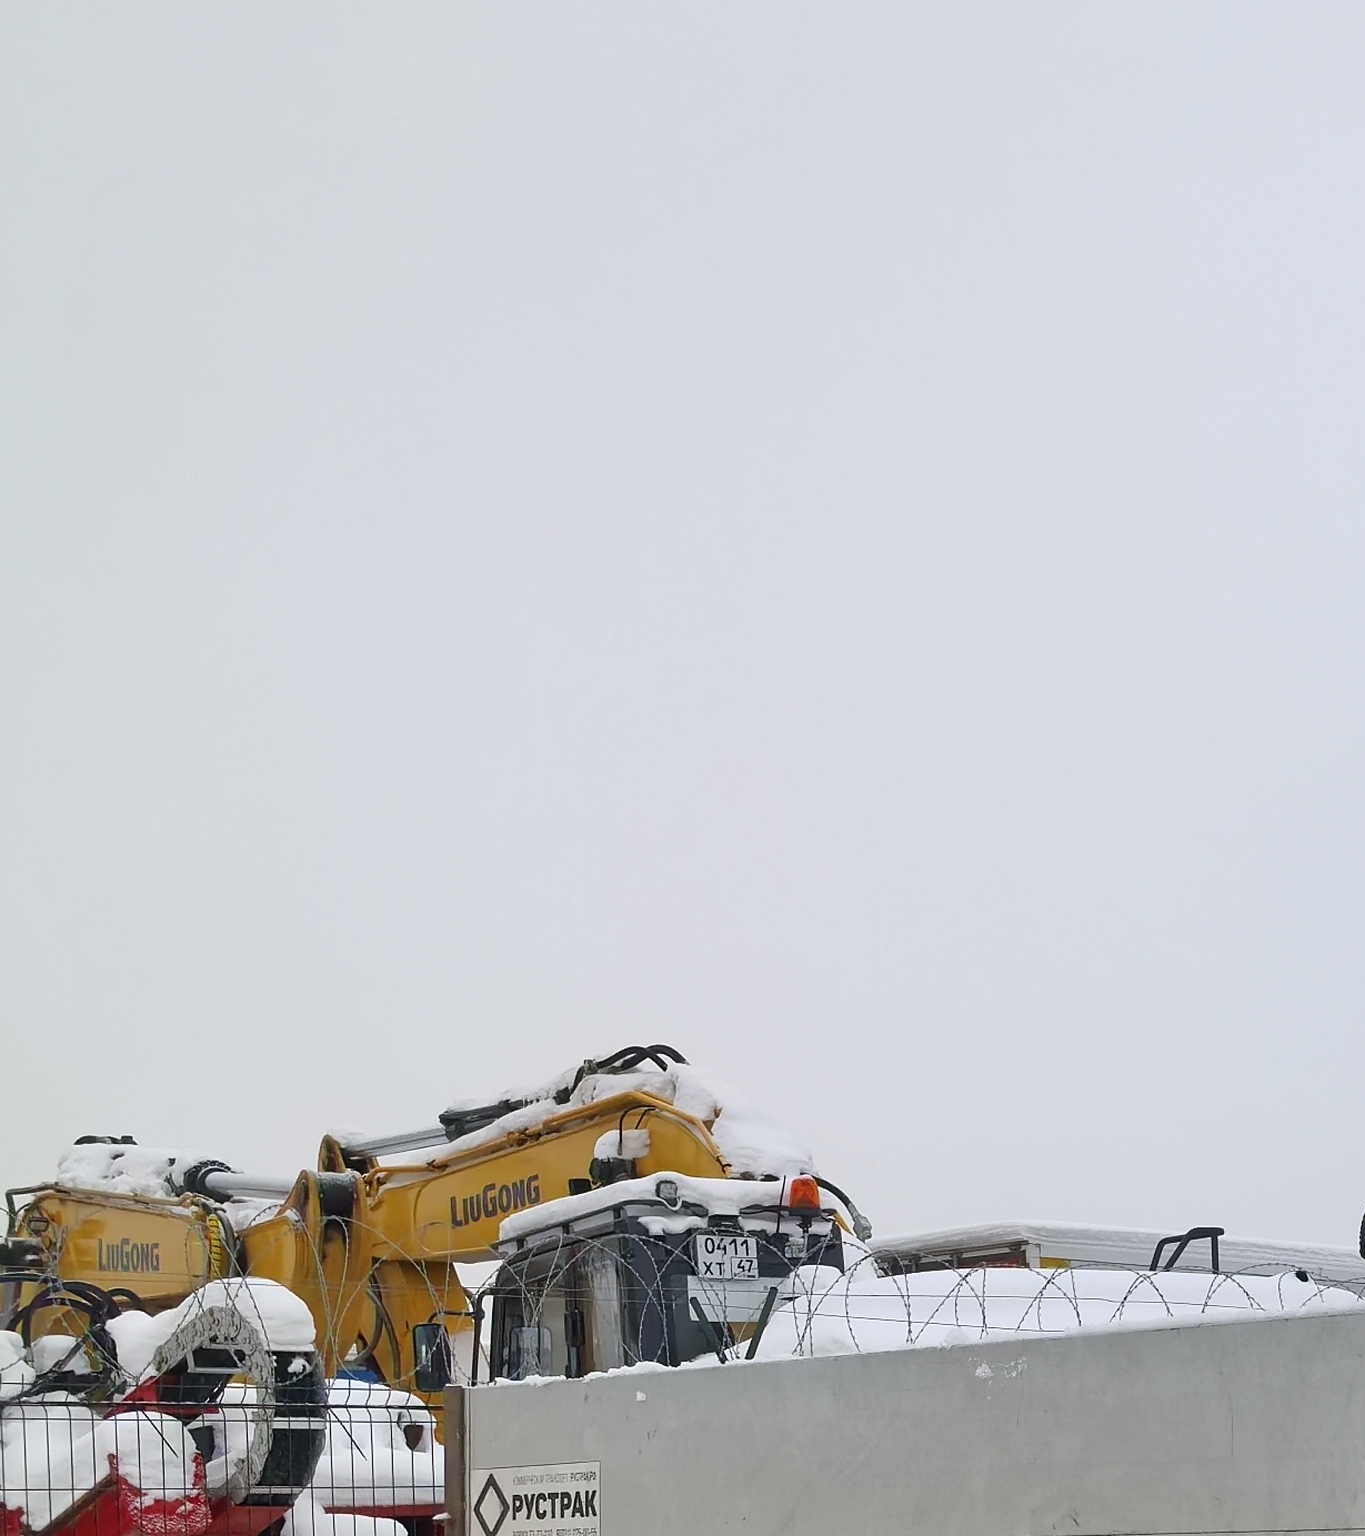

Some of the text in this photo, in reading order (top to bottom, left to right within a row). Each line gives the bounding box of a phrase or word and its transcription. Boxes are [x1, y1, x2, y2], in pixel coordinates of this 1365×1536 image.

[704, 1237, 750, 1257] 0411
[736, 1259, 754, 1274] 47
[511, 1489, 598, 1521] РУСТРАК
